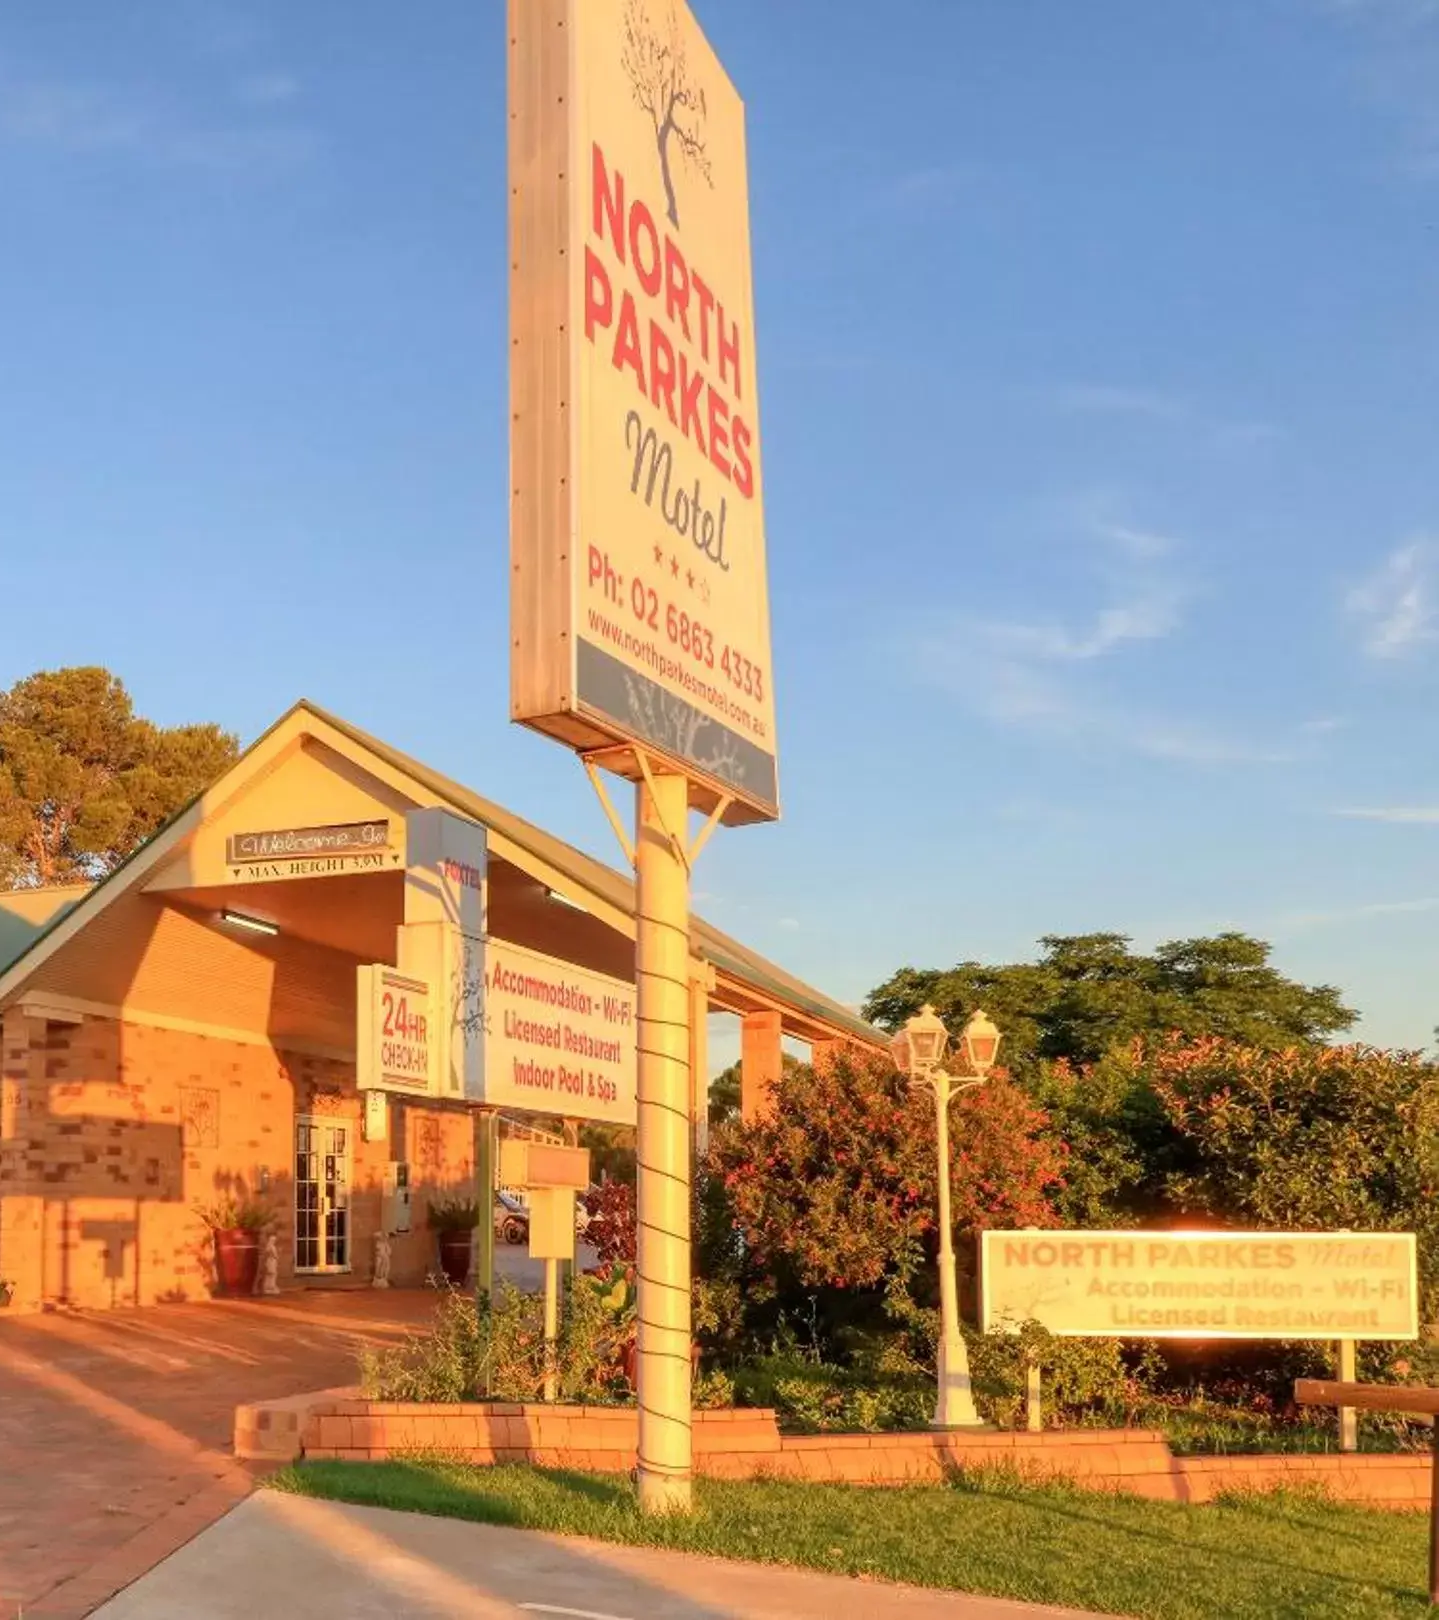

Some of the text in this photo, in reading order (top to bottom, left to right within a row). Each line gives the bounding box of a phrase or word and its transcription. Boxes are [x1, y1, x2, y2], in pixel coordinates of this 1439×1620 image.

[592, 140, 741, 400] NORTH
[585, 244, 754, 500] PARKES
[625, 410, 729, 571] Motel
[588, 543, 764, 703] Ph: 02 6863 4333
[588, 608, 765, 737] www.northparkesmotel.com.au
[240, 831, 348, 853] Welcome
[289, 856, 344, 874] HEIGHT
[492, 960, 592, 1016] Accommodation
[603, 993, 632, 1027] Wi-Fi
[504, 1009, 621, 1064] Licensed Restaurant
[513, 1056, 617, 1105] Indoor Pool & Spa
[1003, 1241, 1396, 1269] NORTH PARKES Motel
[1086, 1276, 1303, 1299] Accommodation
[1333, 1277, 1404, 1300] Wi-Fi
[1111, 1303, 1379, 1327] Licensed Restaurant
